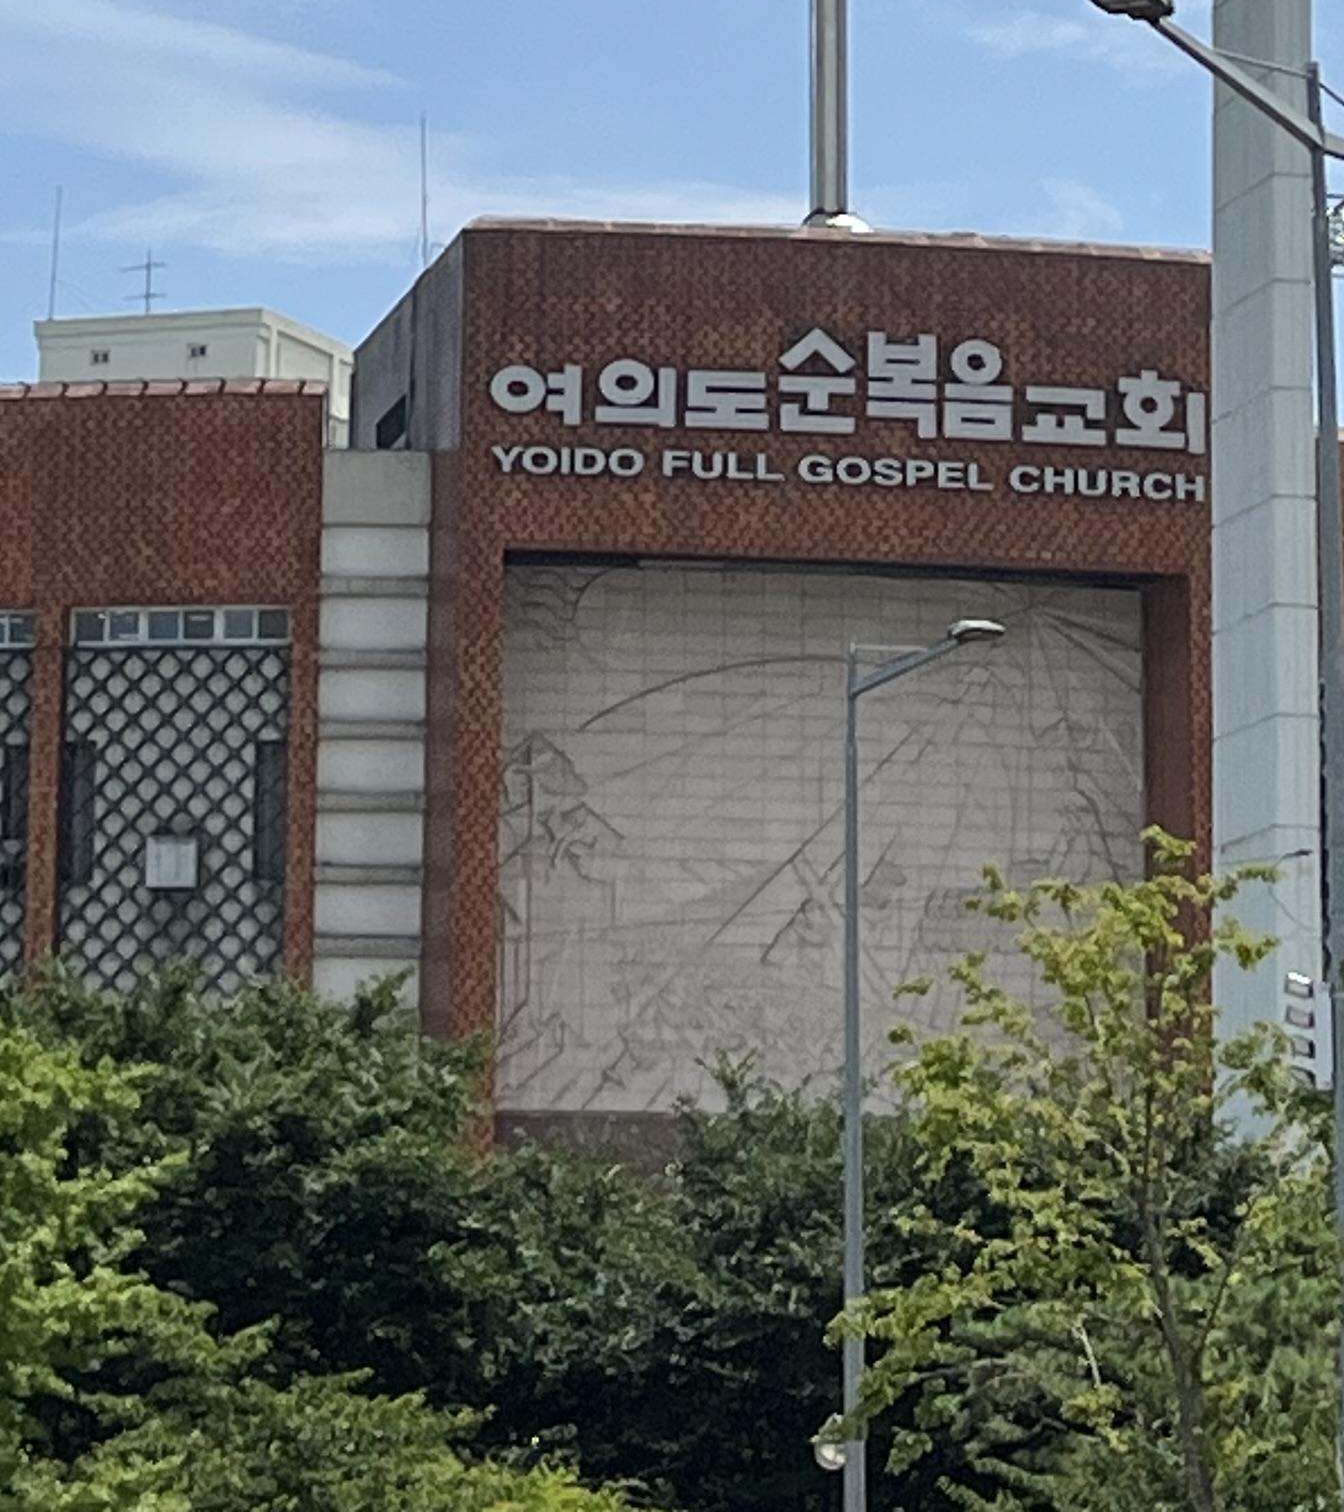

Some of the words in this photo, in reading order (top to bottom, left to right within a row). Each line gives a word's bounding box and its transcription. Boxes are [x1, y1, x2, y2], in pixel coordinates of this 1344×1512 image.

[489, 326, 1206, 455] 여의도순복음교회
[490, 444, 645, 479] YOIDO
[662, 450, 785, 482] FULL
[797, 454, 994, 491] GOSPEL
[1009, 464, 1206, 503] CHURCH
